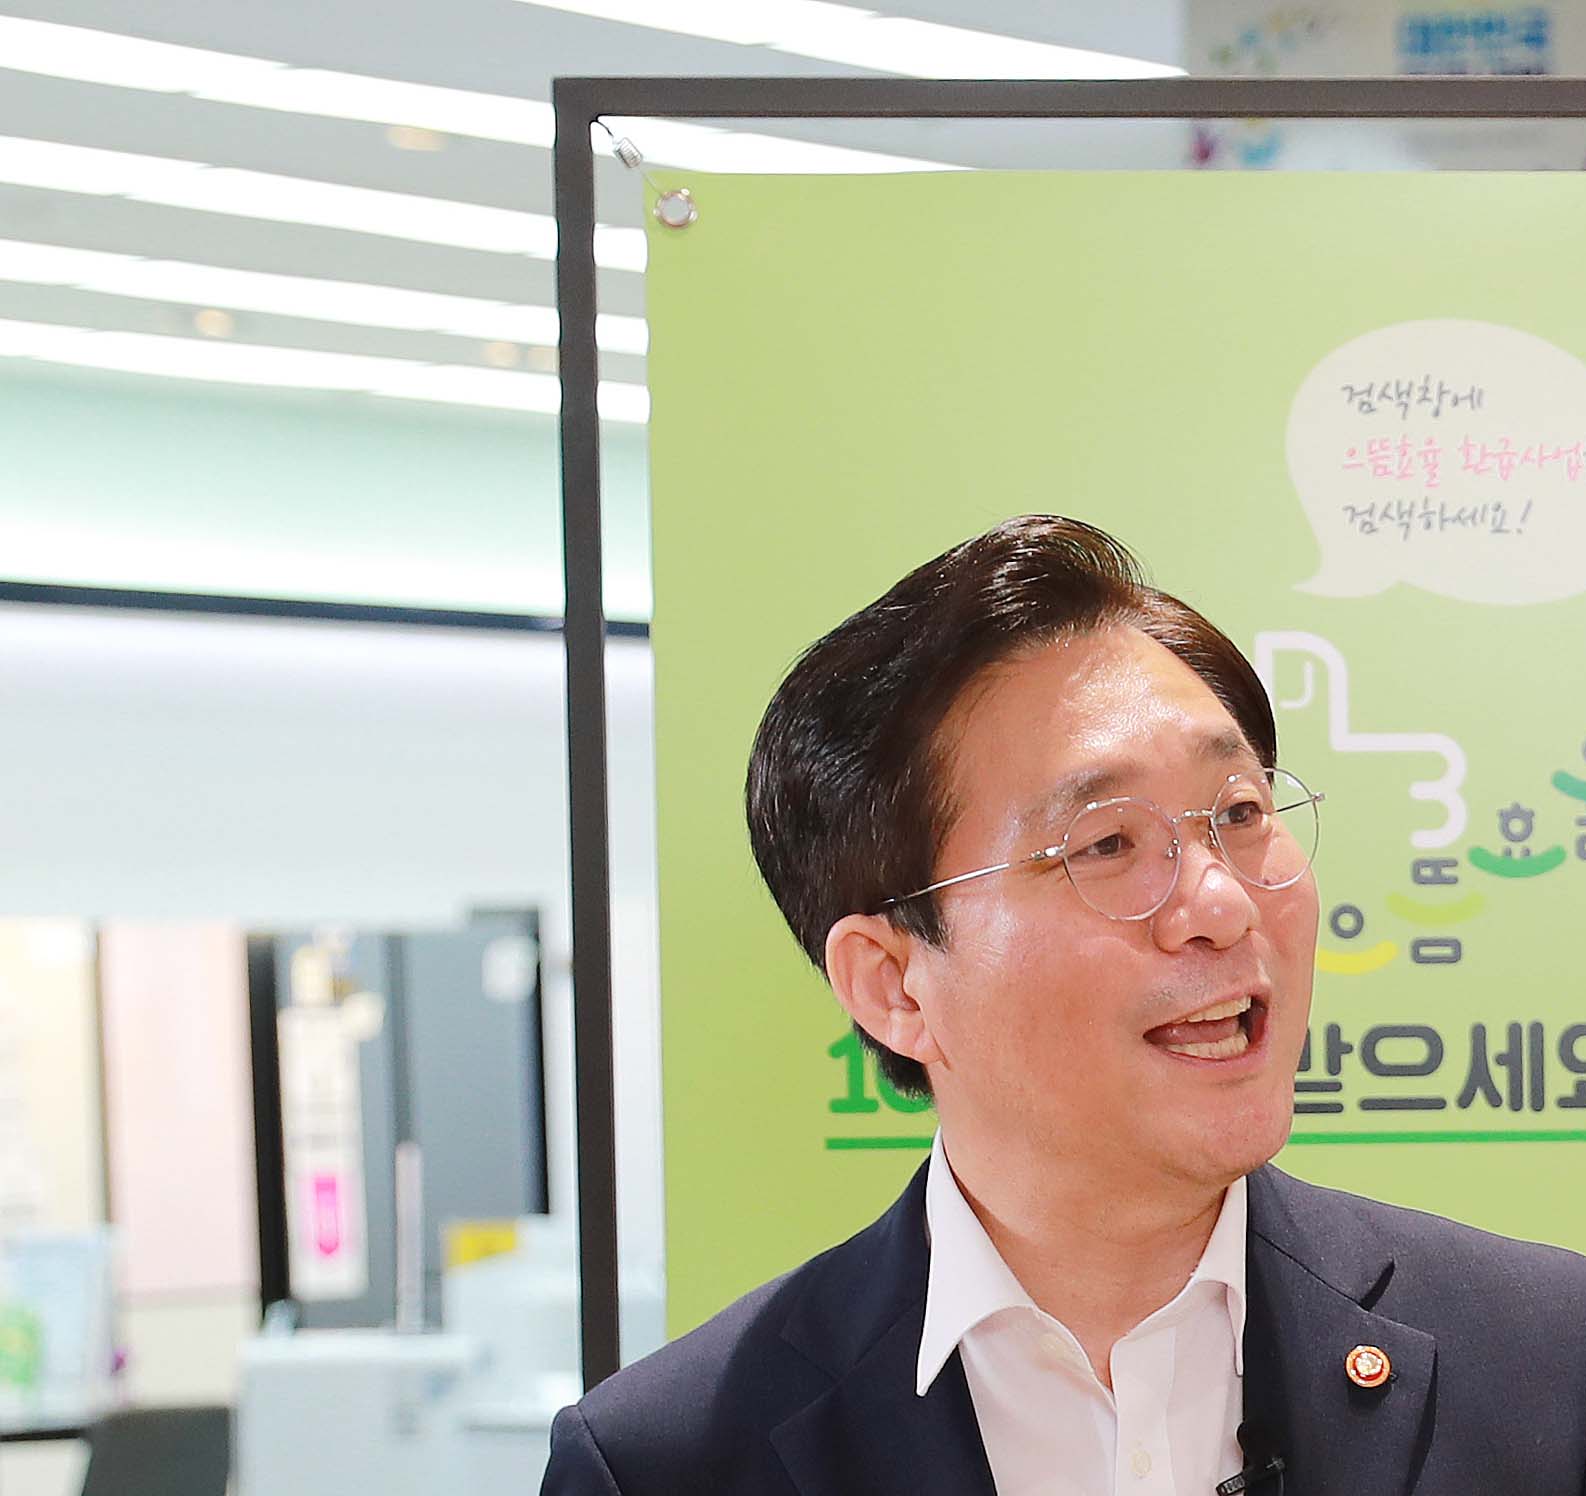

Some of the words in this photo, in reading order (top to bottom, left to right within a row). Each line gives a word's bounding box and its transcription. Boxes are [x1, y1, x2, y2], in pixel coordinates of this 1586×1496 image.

[1341, 374, 1486, 419] 검색창에
[1341, 433, 1443, 488] 으뜸효율
[1341, 498, 1533, 541] 검색하세요!
